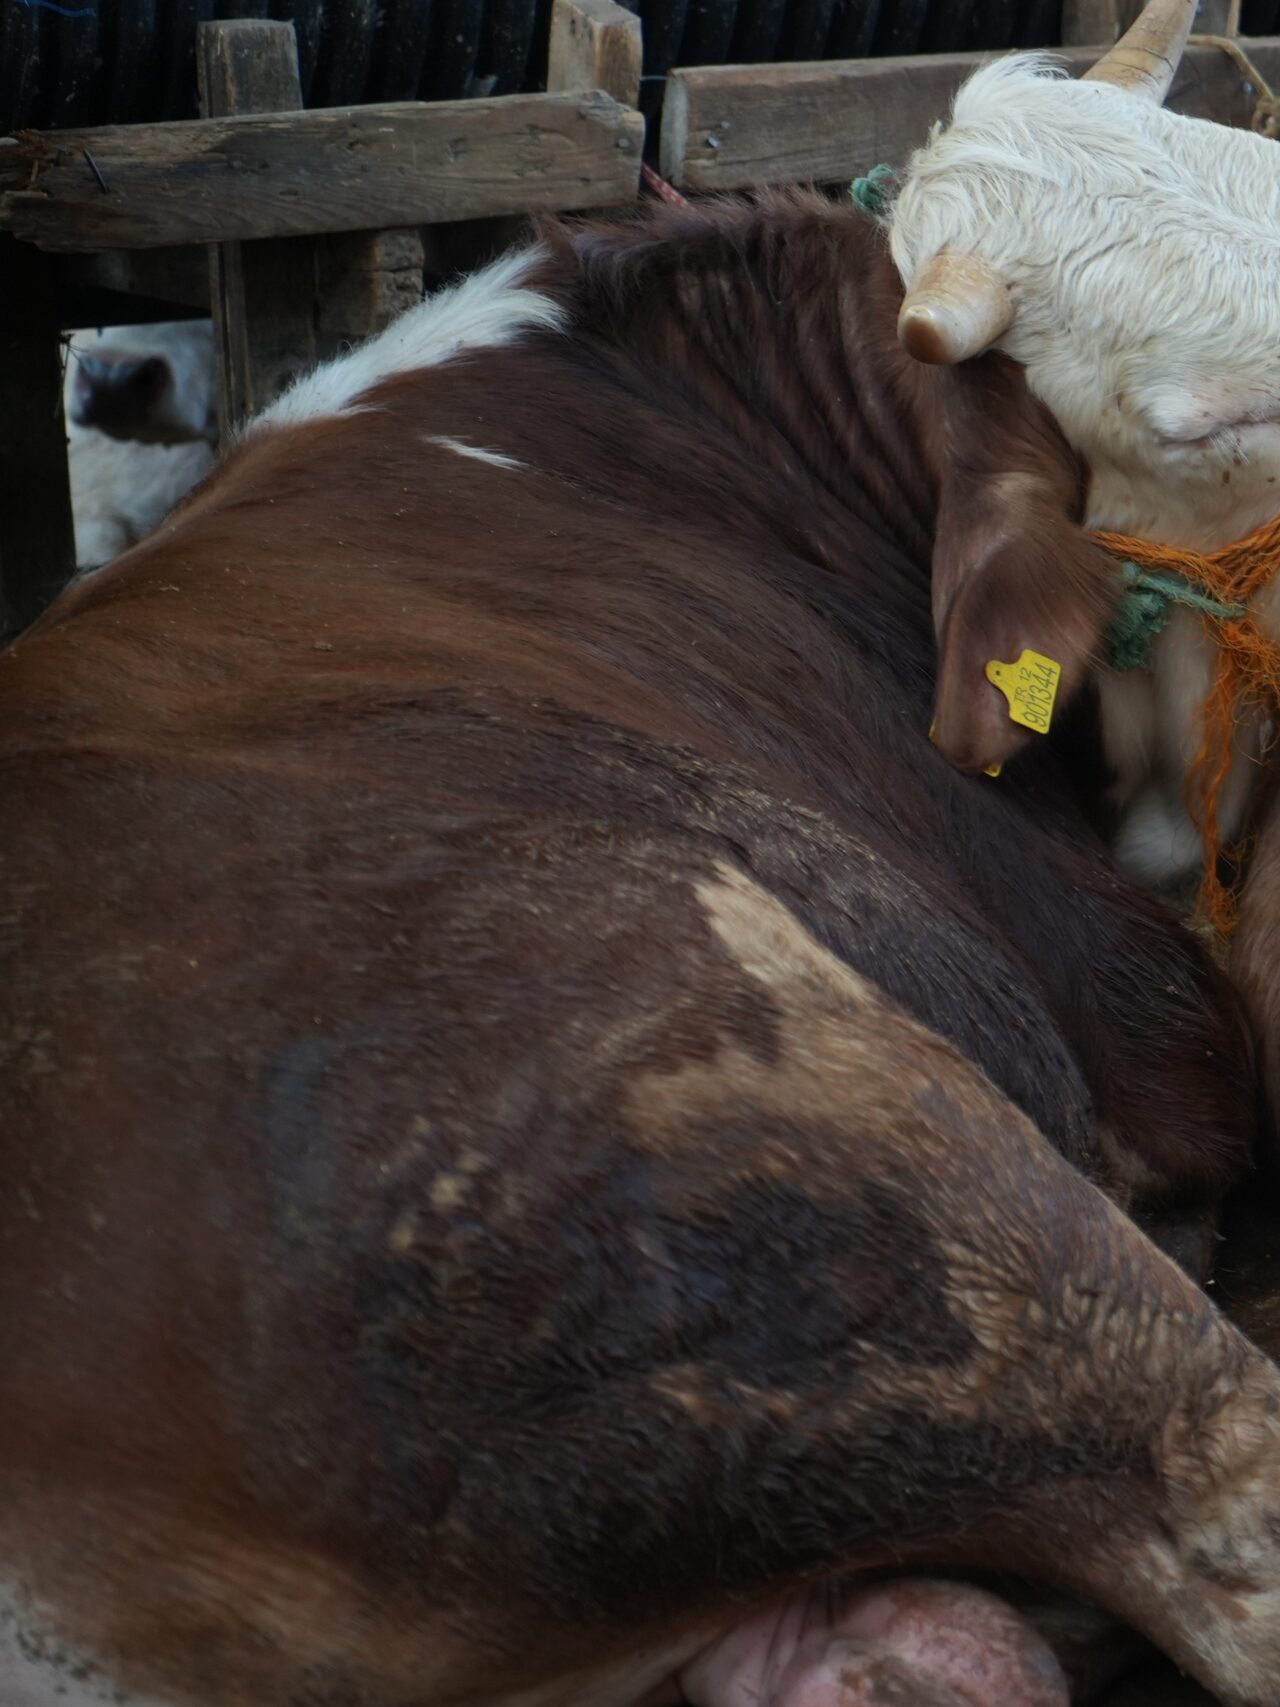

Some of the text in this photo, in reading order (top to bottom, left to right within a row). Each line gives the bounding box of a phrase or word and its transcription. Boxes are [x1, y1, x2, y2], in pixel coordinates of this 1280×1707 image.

[1014, 667, 1032, 703] TR 12
[1022, 662, 1057, 728] 901344
